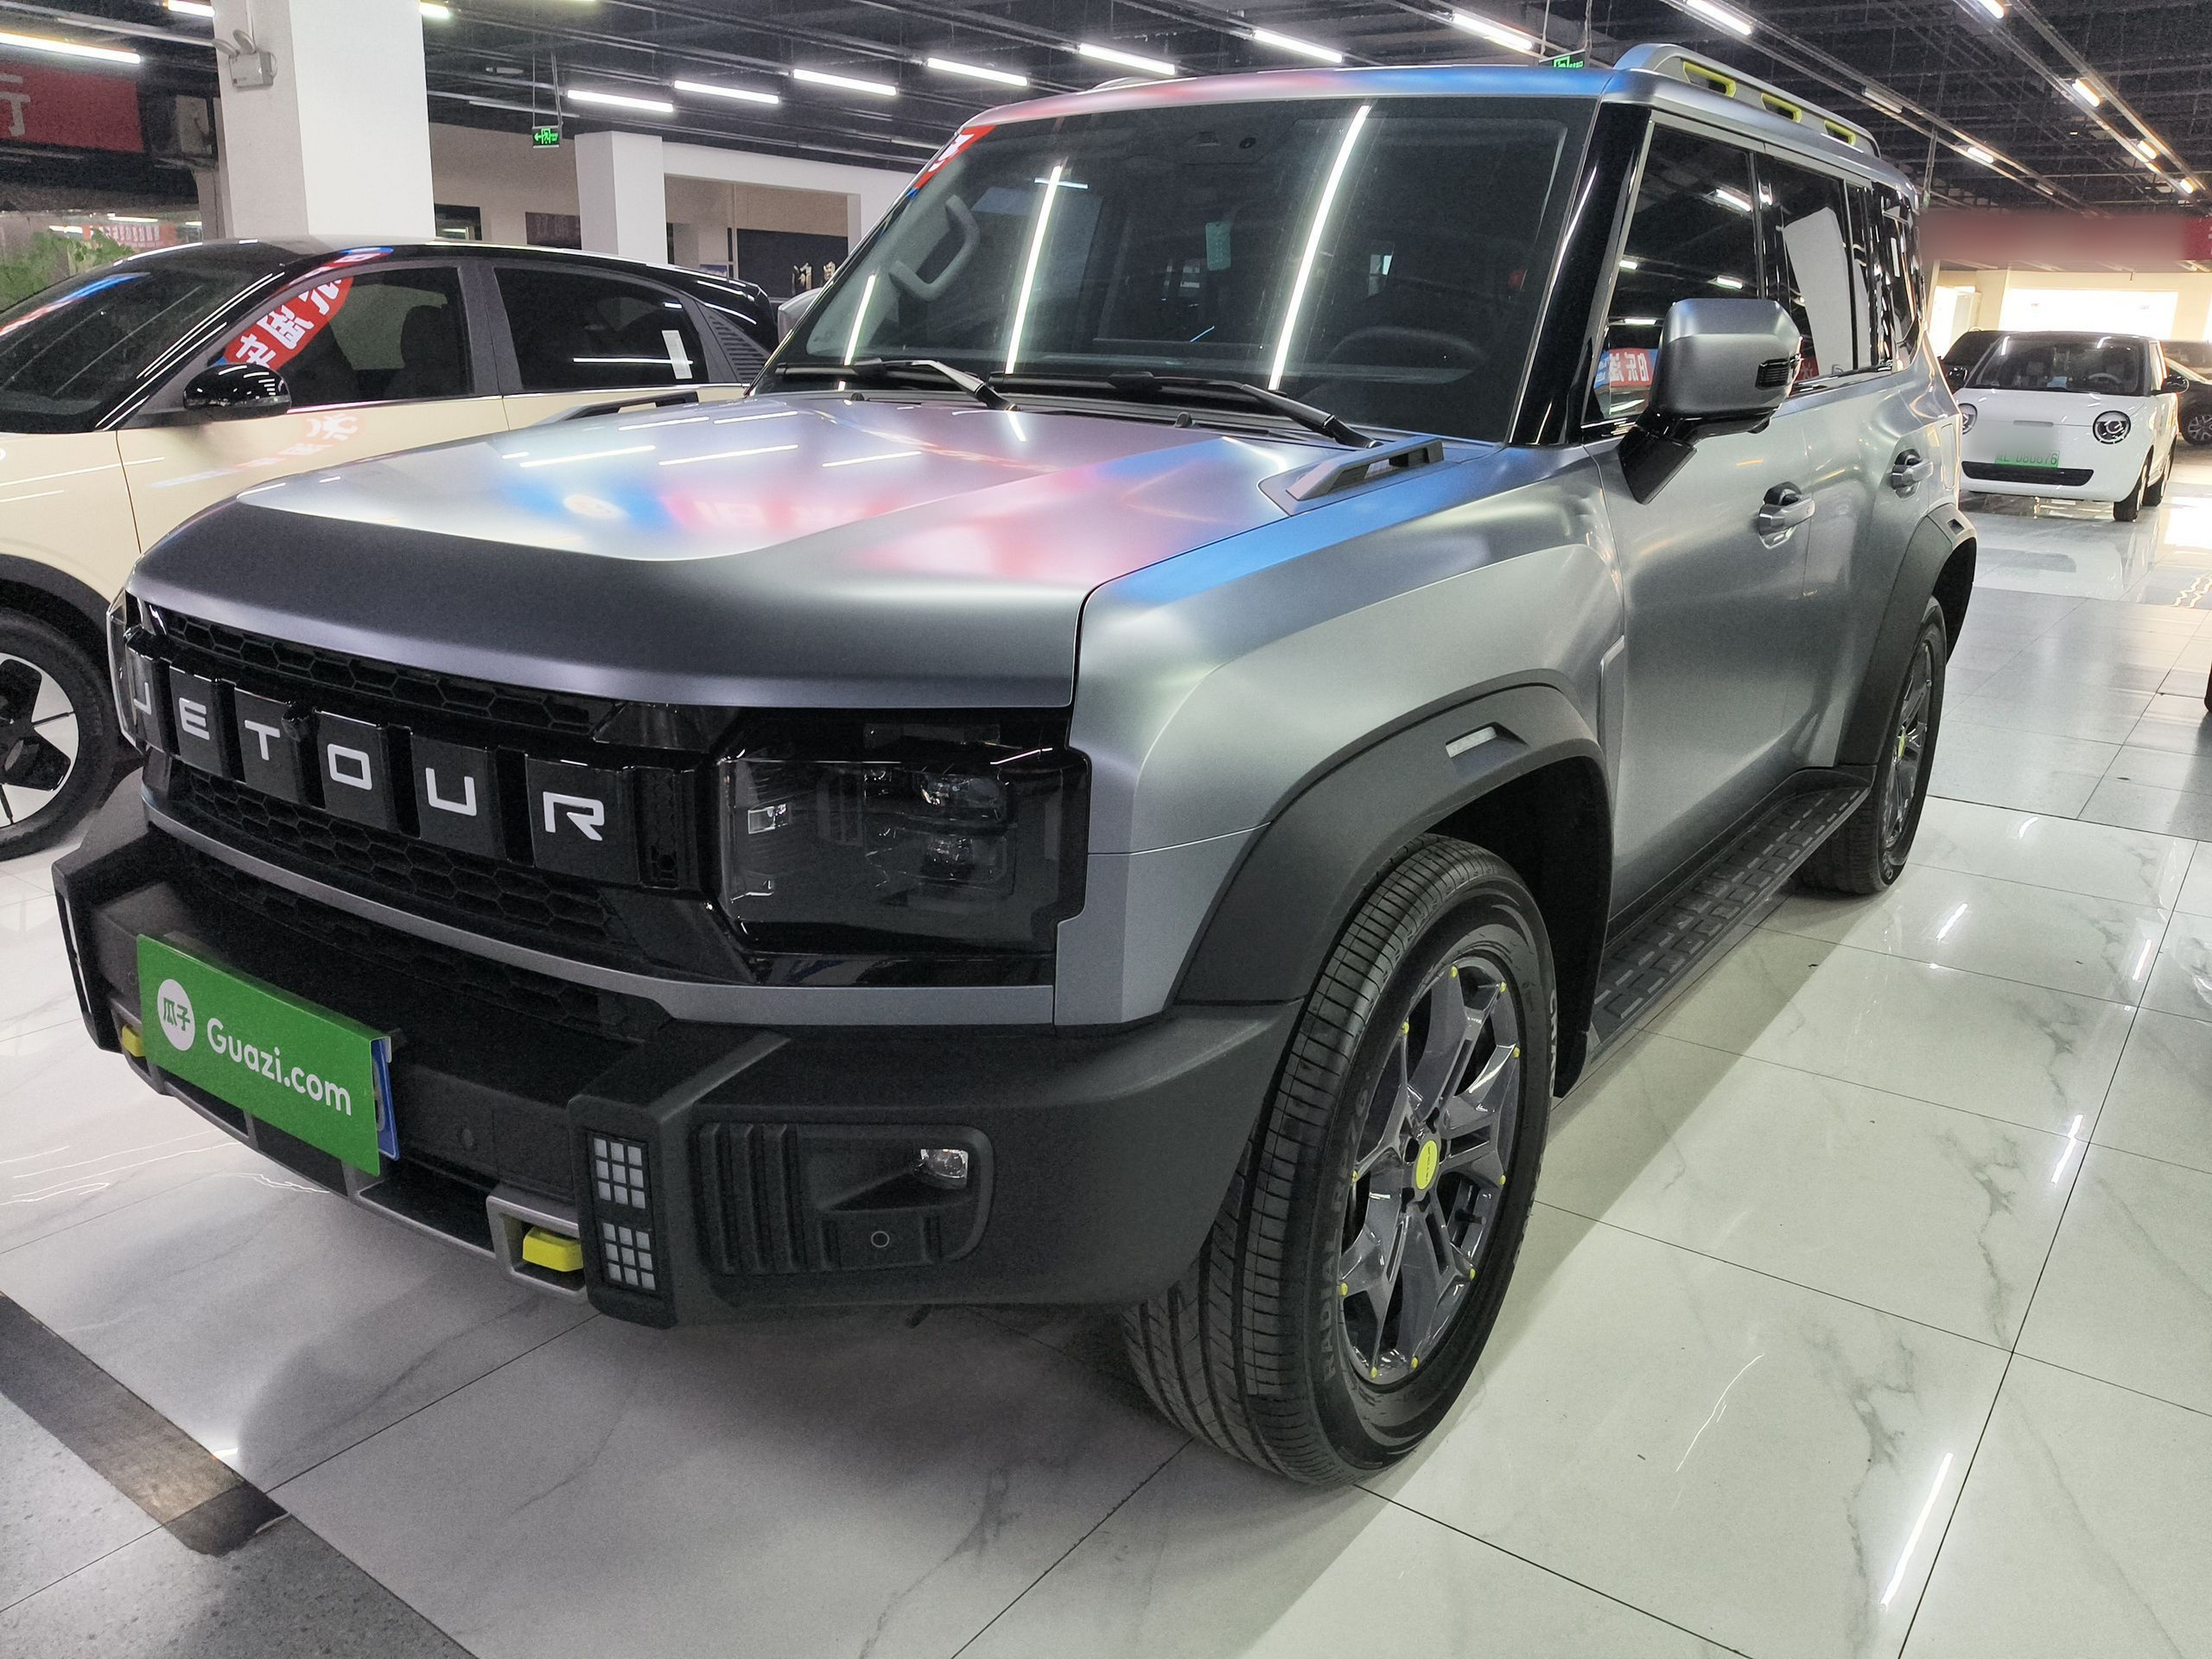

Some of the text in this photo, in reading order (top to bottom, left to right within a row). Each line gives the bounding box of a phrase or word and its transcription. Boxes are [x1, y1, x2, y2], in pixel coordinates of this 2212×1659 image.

[133, 682, 605, 841] JETOUR
[163, 997, 352, 1116] 瓜子 Guazi.com
